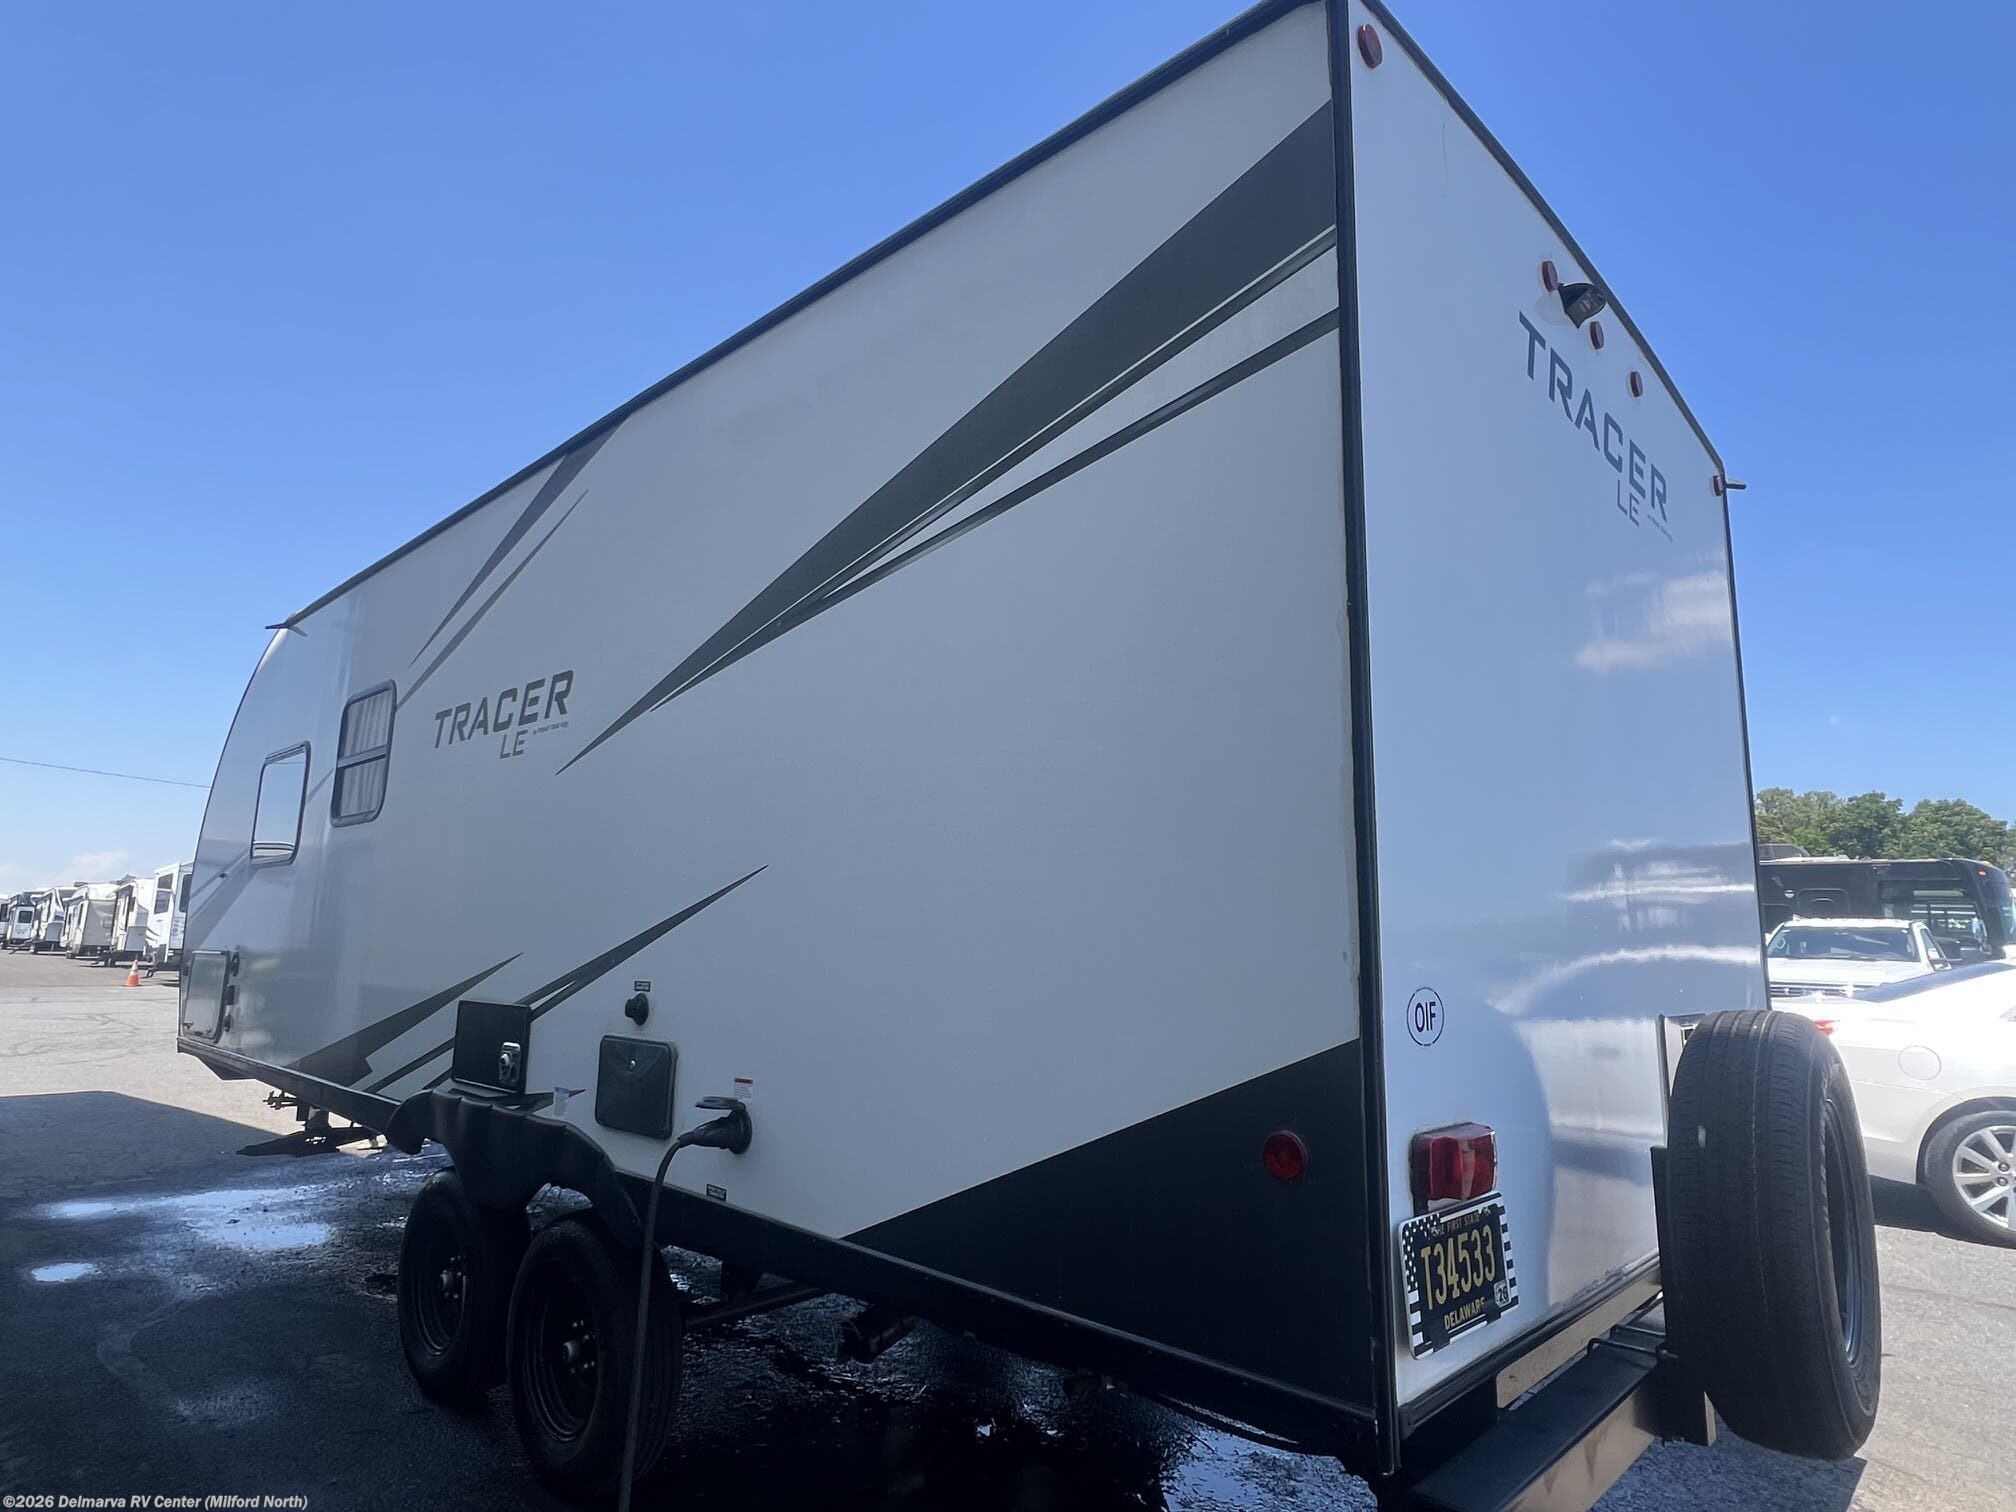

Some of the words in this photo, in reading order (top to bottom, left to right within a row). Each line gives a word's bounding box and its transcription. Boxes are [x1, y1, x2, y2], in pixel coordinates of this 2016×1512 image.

[1518, 310, 1668, 523] TRACER
[1617, 479, 1640, 528] LE
[434, 670, 574, 749] TRACER
[500, 729, 528, 760] LE
[1414, 1001, 1436, 1033] OIF
[1420, 1224, 1497, 1311] T34533
